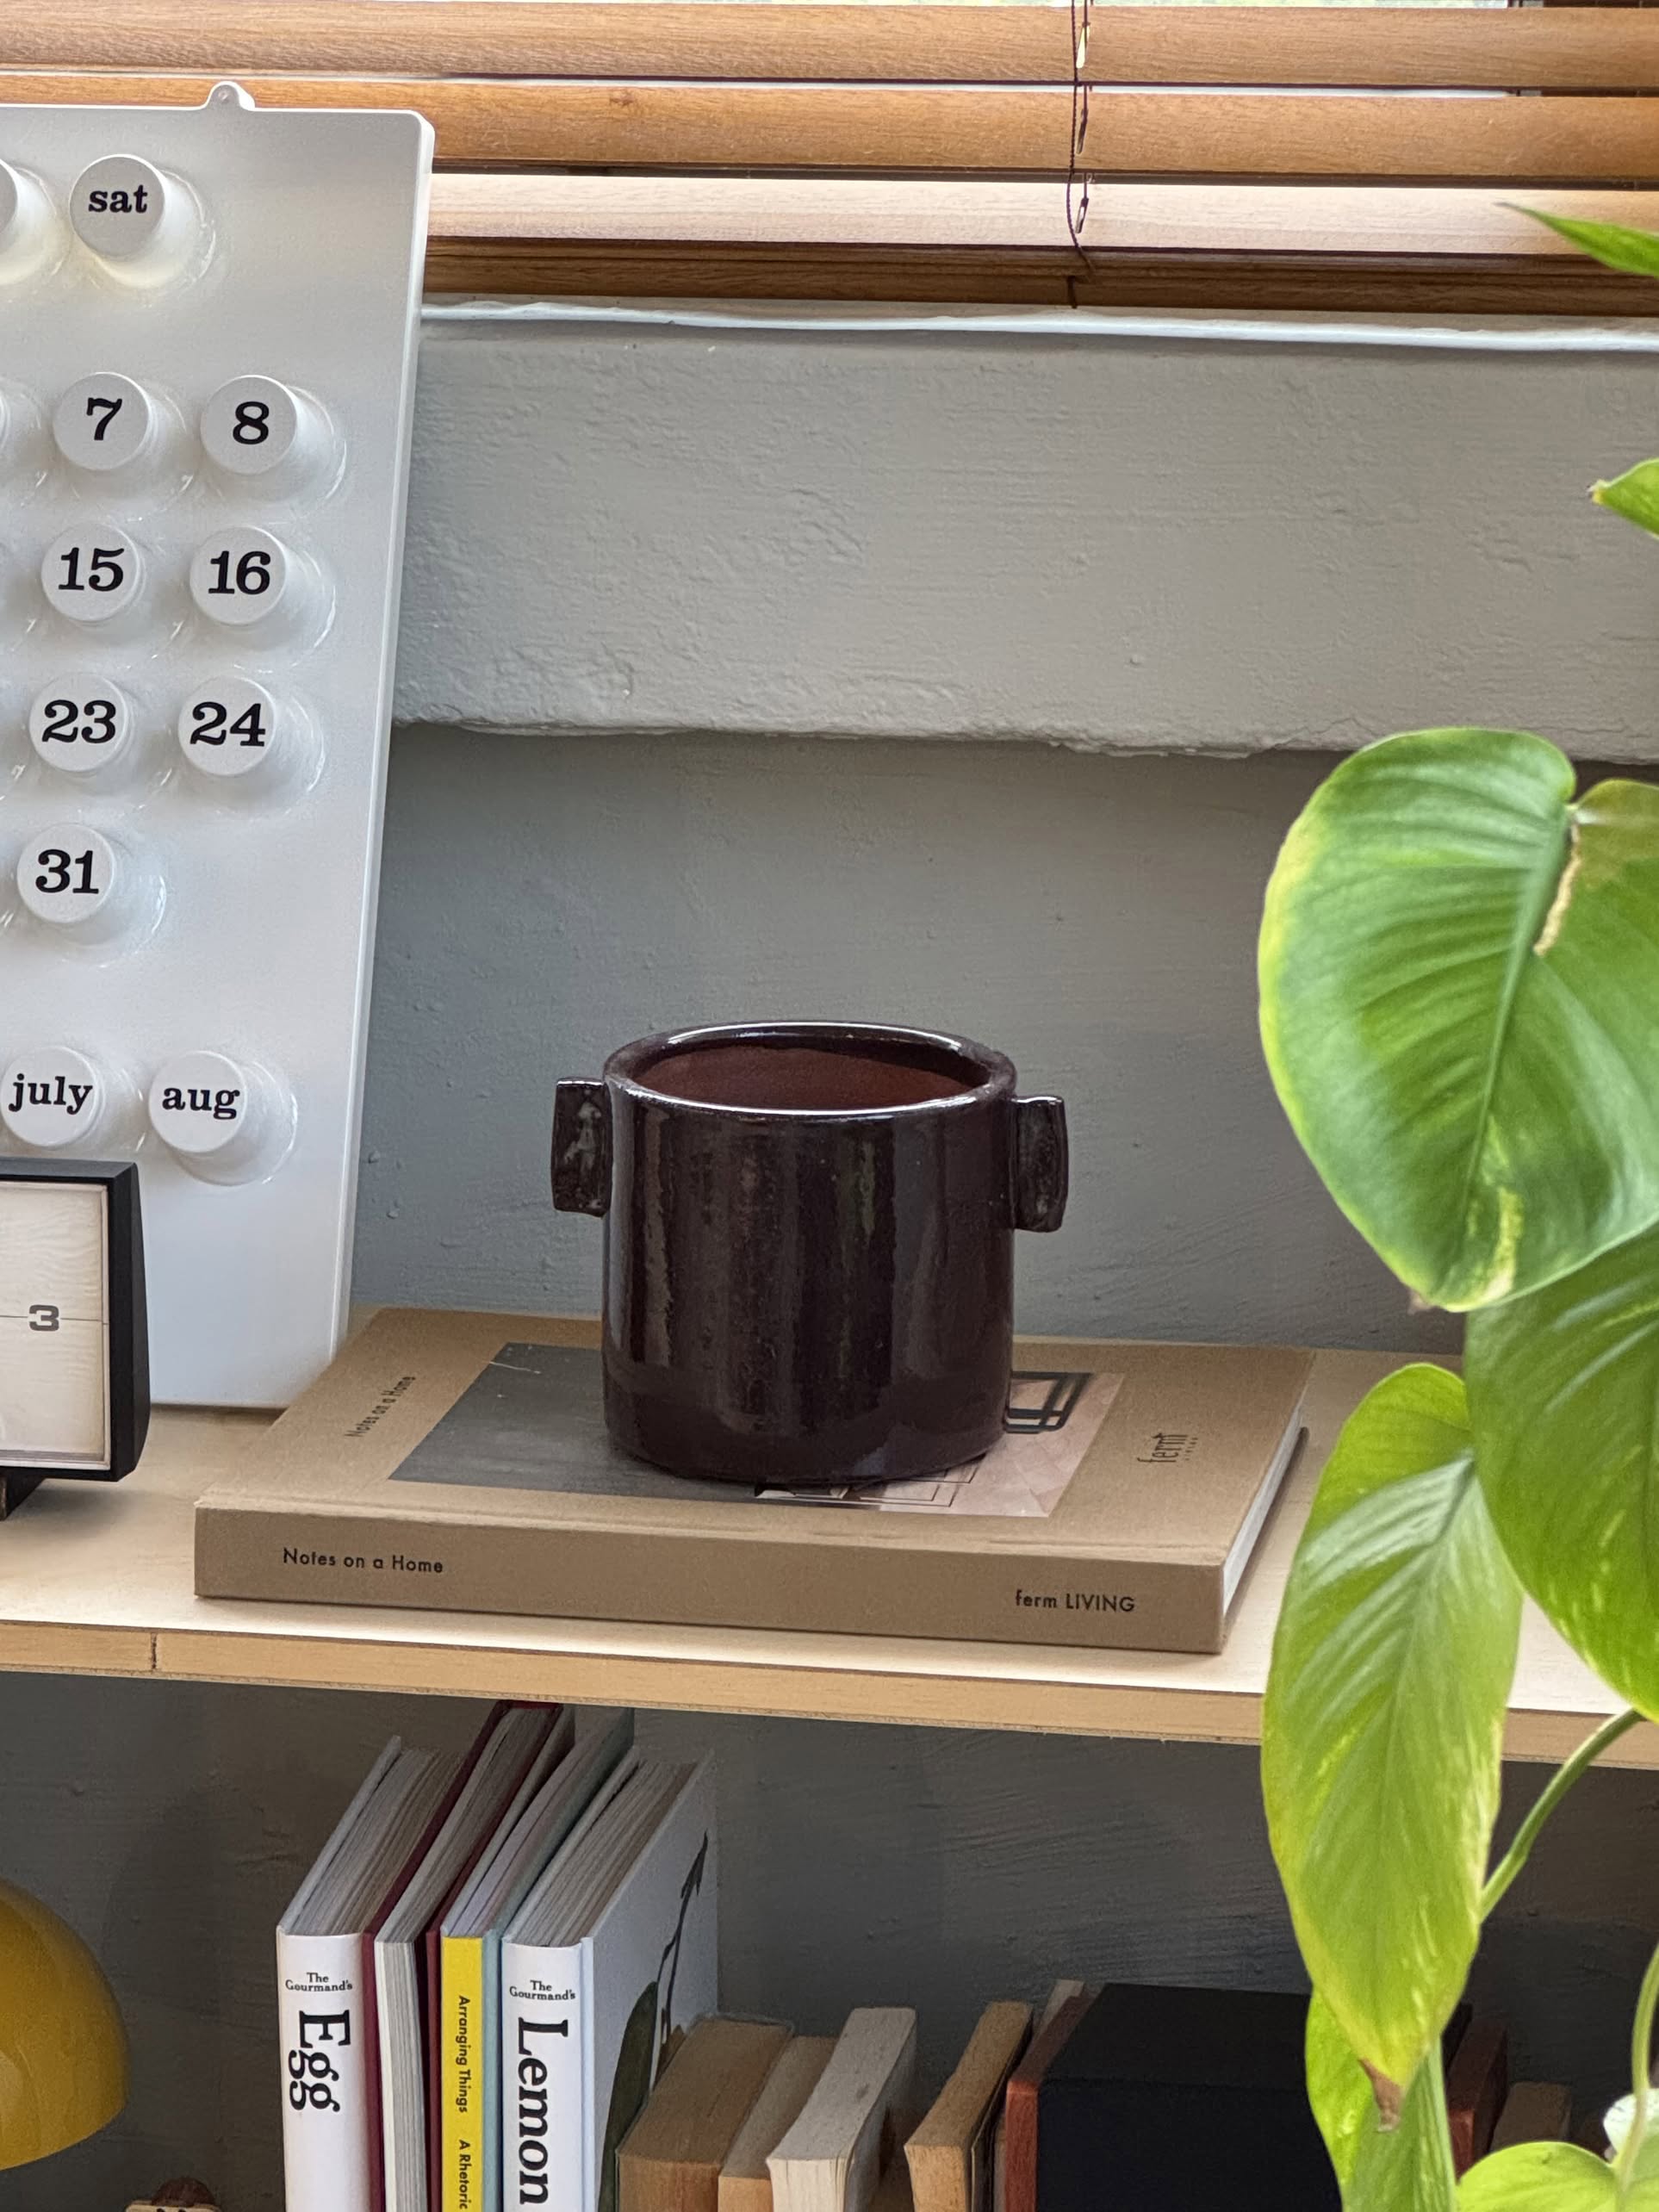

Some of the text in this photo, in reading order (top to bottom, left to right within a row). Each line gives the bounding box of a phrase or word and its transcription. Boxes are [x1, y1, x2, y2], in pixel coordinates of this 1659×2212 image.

[88, 184, 148, 214] sat
[85, 398, 270, 444] 7 8
[58, 547, 271, 595] 15 16
[41, 699, 266, 747] 23 24
[34, 848, 100, 895] 31
[8, 1073, 240, 1120] july aug
[28, 1304, 60, 1333] 3
[380, 1376, 417, 1397] Home
[371, 1405, 390, 1414] on
[344, 1416, 380, 1438] Notes
[1136, 1432, 1189, 1463] ferm
[283, 1547, 444, 1574] Notes on a Home
[1016, 1588, 1135, 1612] ferm LIVING
[284, 1979, 353, 1992] Gourmand's
[306, 1972, 330, 1983] The
[530, 1980, 552, 1992] The
[509, 1985, 576, 2002] Gourmand's
[288, 2009, 351, 2113] Egg
[455, 1995, 472, 2209] Arranging Things A Rhetoric
[517, 2016, 569, 2205] Lemon
